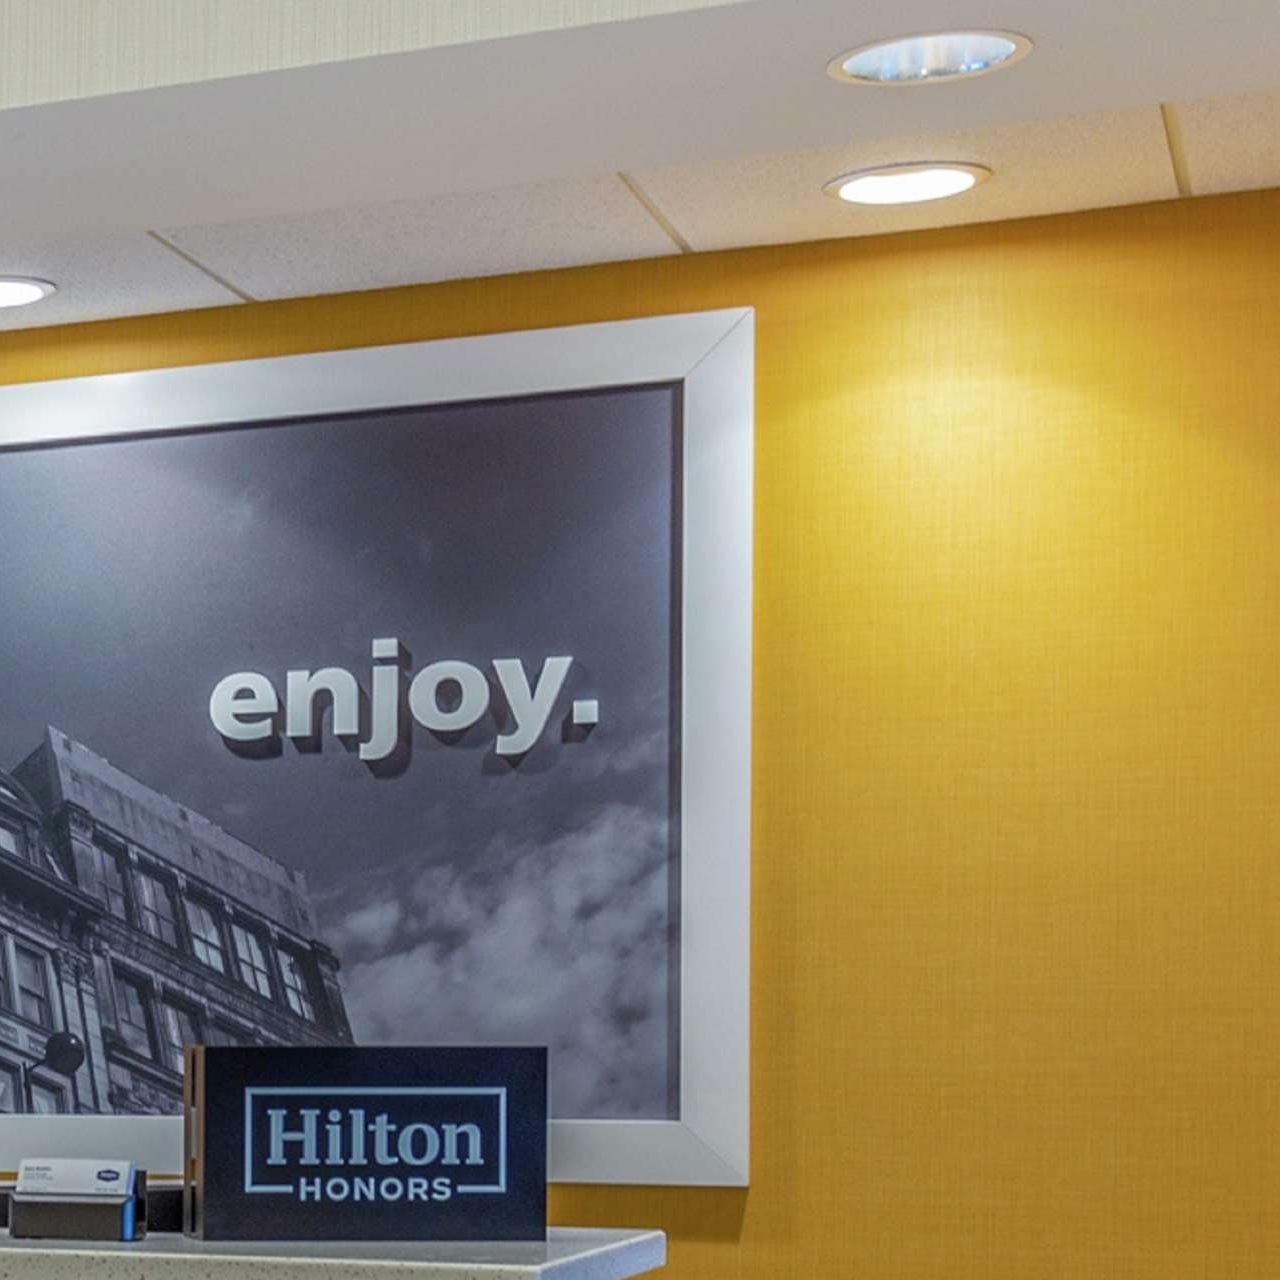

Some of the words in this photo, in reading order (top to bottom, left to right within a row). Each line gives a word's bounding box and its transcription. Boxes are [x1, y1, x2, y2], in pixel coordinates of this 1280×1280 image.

[210, 638, 598, 760] enjoy.
[267, 1108, 485, 1167] Hilton
[299, 1177, 452, 1201] HONORS
